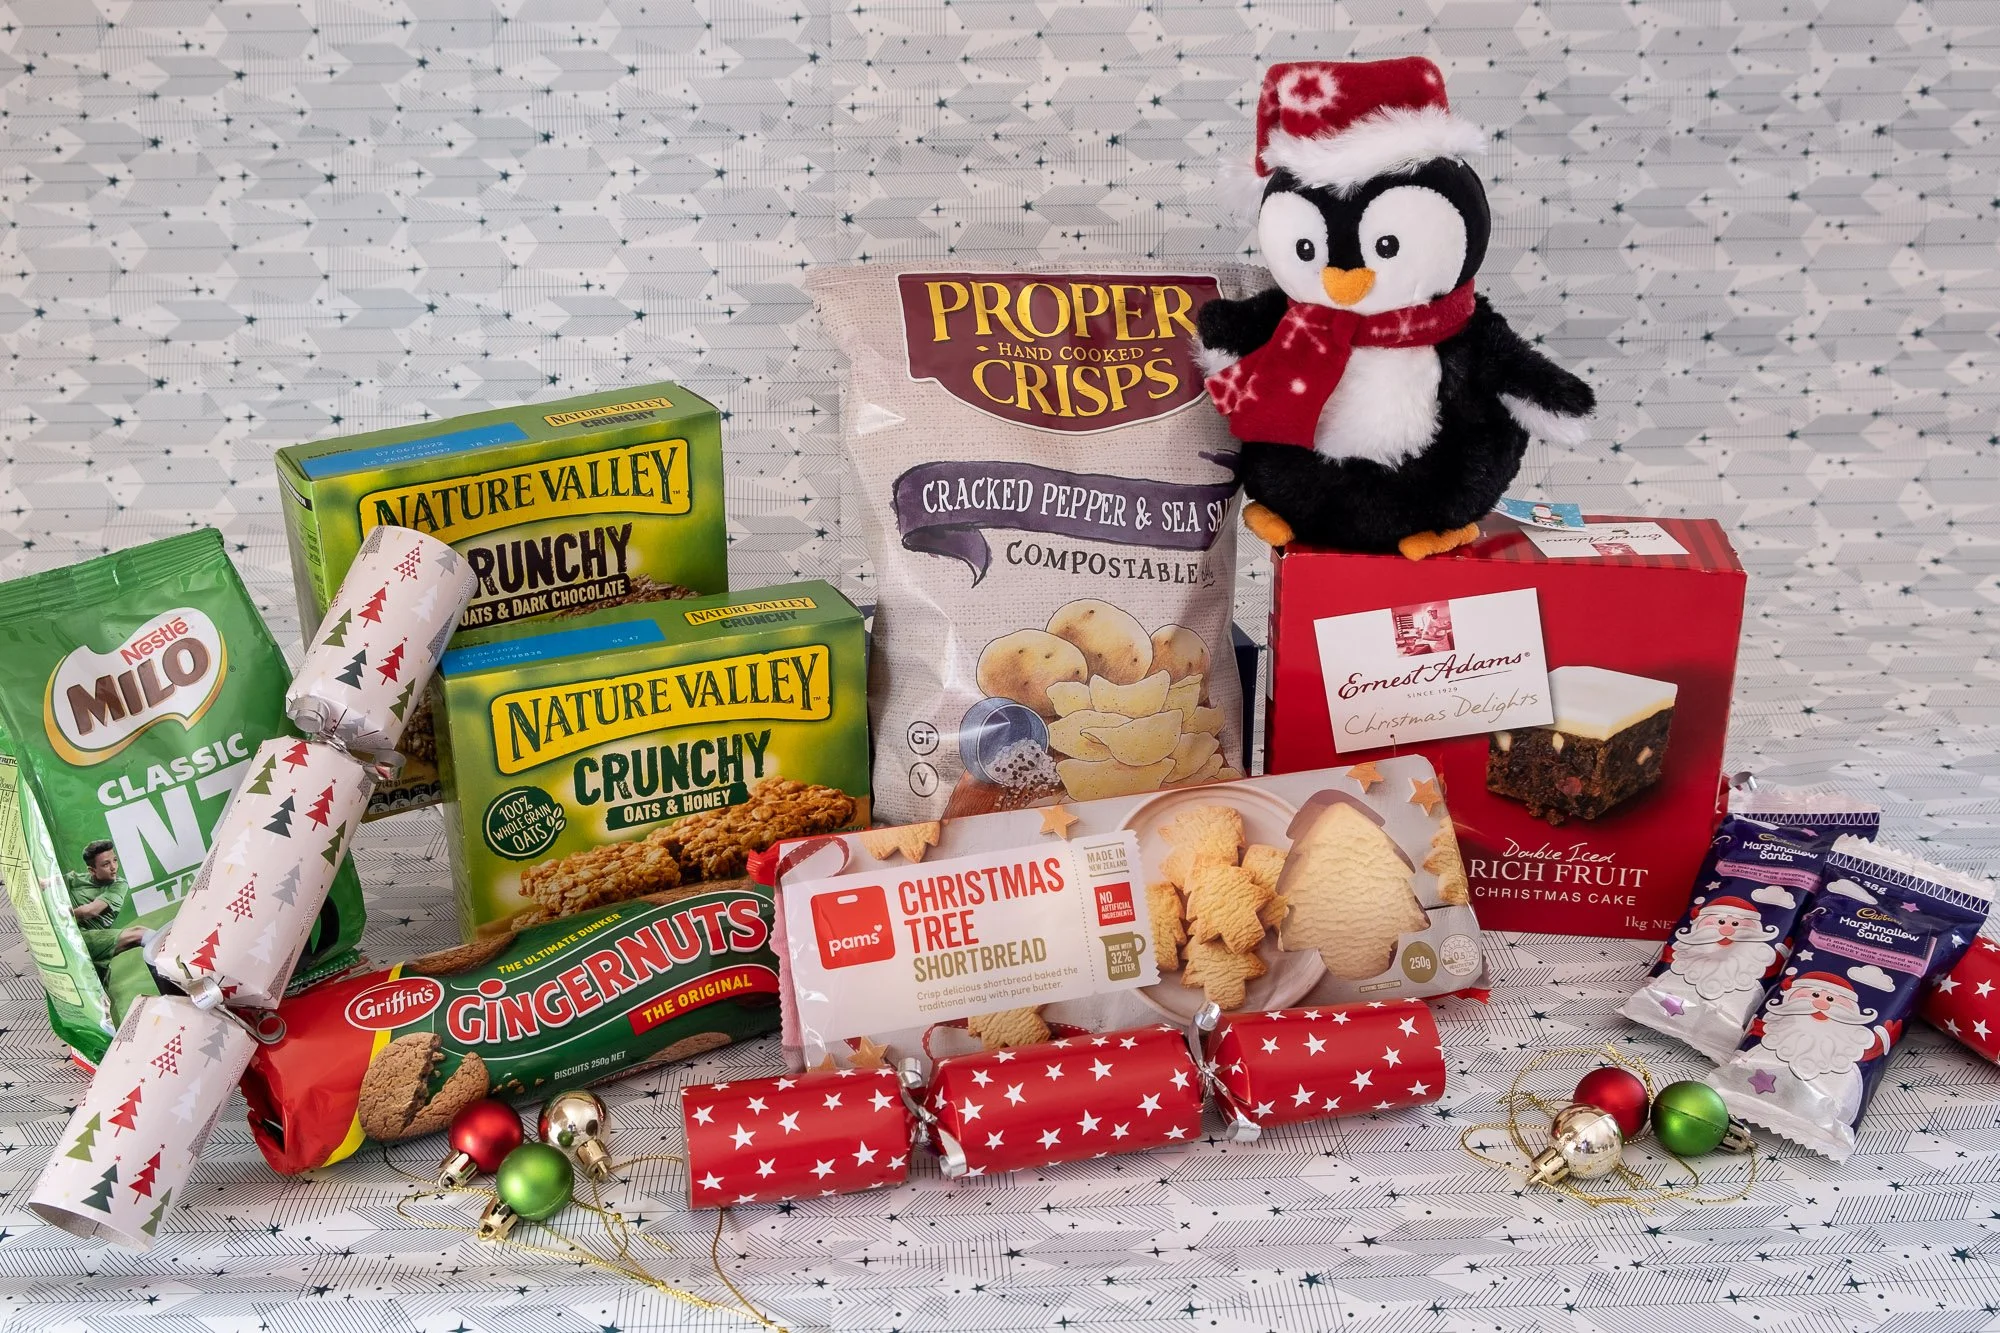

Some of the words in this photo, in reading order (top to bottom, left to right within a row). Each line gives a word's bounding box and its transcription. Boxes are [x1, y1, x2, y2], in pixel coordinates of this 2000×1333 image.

[925, 281, 1197, 342] PROPER
[998, 342, 1052, 362] HAND
[1059, 346, 1144, 363] COOKED
[972, 358, 1179, 418] CRISPS
[550, 407, 611, 425] NATURE
[610, 398, 667, 412] VALLEY
[580, 410, 657, 428] CRUNCHY
[373, 474, 534, 534] NATURE
[538, 446, 679, 504] VALLEY
[922, 478, 1034, 514] CRACKED
[1040, 483, 1127, 528] PEPPER
[1135, 497, 1152, 530] &
[1162, 501, 1202, 533] SEA
[467, 522, 632, 599] RUNCHY
[1006, 540, 1198, 584] COMPOSTABLE
[461, 606, 493, 627] OATS
[497, 602, 510, 619] &
[512, 594, 549, 617] DARK
[552, 578, 626, 608] CHOCOLATE
[691, 605, 752, 624] NATURE
[753, 599, 810, 610] VALLEY
[720, 611, 798, 629] CRUNCHY
[66, 637, 211, 736] MILO
[1338, 664, 1431, 700] Ernest
[1424, 652, 1522, 682] Adams
[1407, 690, 1435, 699] SINCE
[1438, 686, 1458, 695] 1929
[506, 678, 672, 762] NATURE
[675, 653, 820, 711] VALLEY
[1344, 708, 1446, 736] Christmas
[1452, 688, 1539, 724] Delights
[912, 730, 934, 745] GF
[97, 733, 248, 806] CLASSIC
[573, 728, 772, 806] CRUNCHY
[916, 772, 928, 787] V
[499, 796, 534, 821] 100%
[624, 803, 661, 824] OATS
[666, 799, 679, 816] &
[684, 789, 731, 813] HONEY
[492, 817, 526, 841] WHOLE
[524, 803, 552, 825] GRAIN
[512, 823, 548, 852] OATS
[1502, 837, 1563, 860] Double
[1565, 842, 1616, 864] Iced
[1743, 840, 1818, 859] Marshmallow
[1086, 850, 1114, 864] MADE
[1116, 847, 1126, 859] IN
[1088, 863, 1102, 872] NEW
[1103, 860, 1128, 870] ZEALAND
[1760, 850, 1794, 862] Santa
[898, 857, 1065, 916] CHRISTMAS
[1469, 858, 1546, 882] RICH
[1553, 864, 1649, 888] FRUIT
[1099, 890, 1113, 904] NO
[1101, 902, 1131, 912] ARTIFICIAL
[1475, 886, 1582, 902] CHRISTMAS
[1588, 893, 1637, 906] CAKE
[1102, 908, 1133, 920] INGREDIENTS
[1624, 916, 1648, 930] 1kg
[1856, 907, 1902, 925] Cadbury
[904, 909, 980, 954] TREE
[1840, 916, 1920, 942] Marshmallow
[1856, 929, 1894, 944] Santa
[497, 960, 522, 976] THE
[523, 934, 578, 967] ULTIMATE
[576, 912, 622, 939] DUNKER
[828, 930, 880, 958] pams
[1108, 944, 1120, 952] MADE
[1120, 942, 1132, 950] WITH
[1111, 950, 1132, 965] 32%
[913, 937, 1048, 984] SHORTBREAD
[1110, 962, 1136, 975] BUTTER
[1409, 956, 1432, 970] 250g
[917, 990, 941, 1002] Crisp
[943, 984, 982, 998] delicious
[984, 974, 1032, 990] shortbread
[1034, 969, 1062, 981] baked
[1063, 966, 1078, 976] the
[919, 998, 966, 1012] traditional
[968, 994, 987, 1006] way
[988, 990, 1008, 1000] with
[1010, 987, 1030, 999] pure
[1032, 980, 1064, 992] butter.
[356, 986, 434, 1020] Griffin's
[642, 1000, 676, 1024] THE
[678, 973, 752, 1008] ORIGINAL
[554, 1062, 590, 1080] BISCUITS
[590, 1057, 610, 1069] 250g
[610, 1050, 626, 1062] NET
